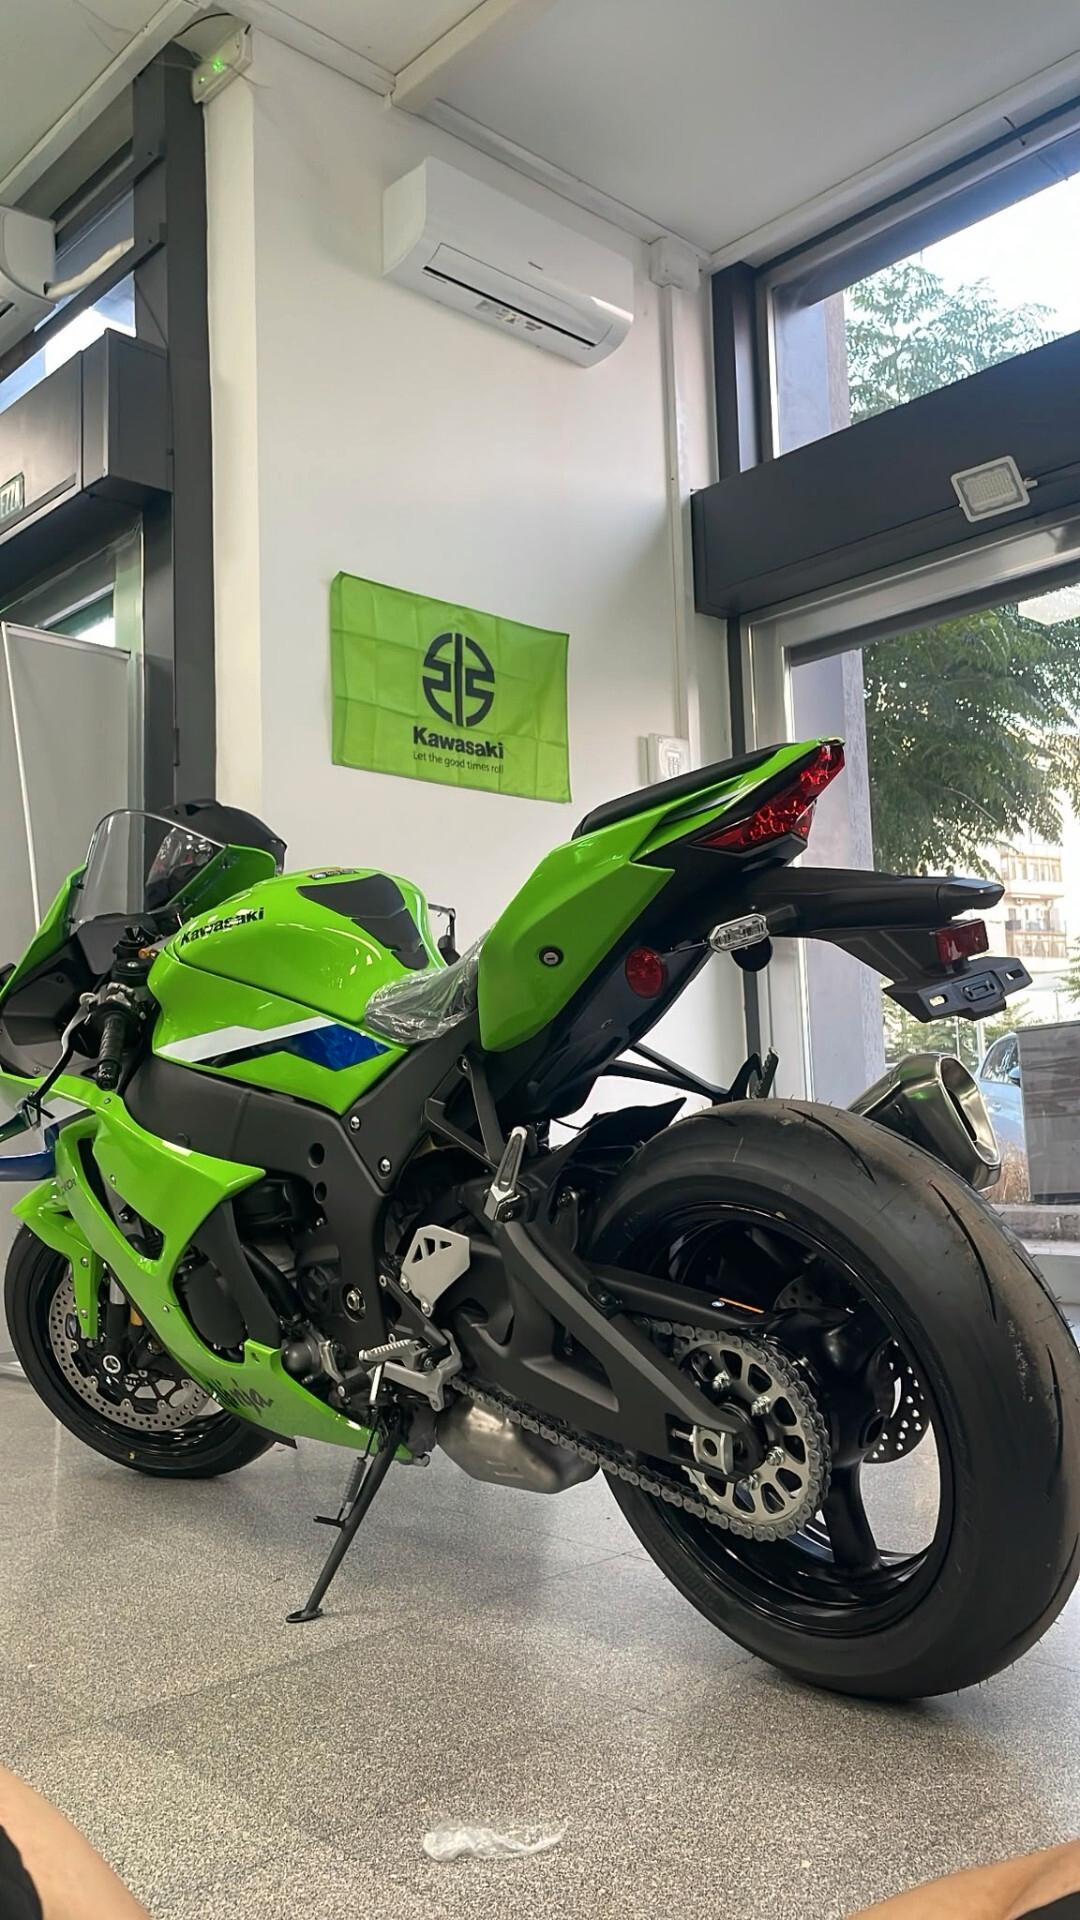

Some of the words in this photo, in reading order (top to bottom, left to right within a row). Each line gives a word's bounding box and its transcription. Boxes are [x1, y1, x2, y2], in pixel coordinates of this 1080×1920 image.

[413, 726, 504, 759] Kawasaki
[413, 752, 427, 761] Let
[428, 752, 442, 764] the
[444, 757, 465, 768] good
[466, 760, 489, 773] times
[491, 764, 504, 775] roll
[181, 907, 264, 946] Kawasaki
